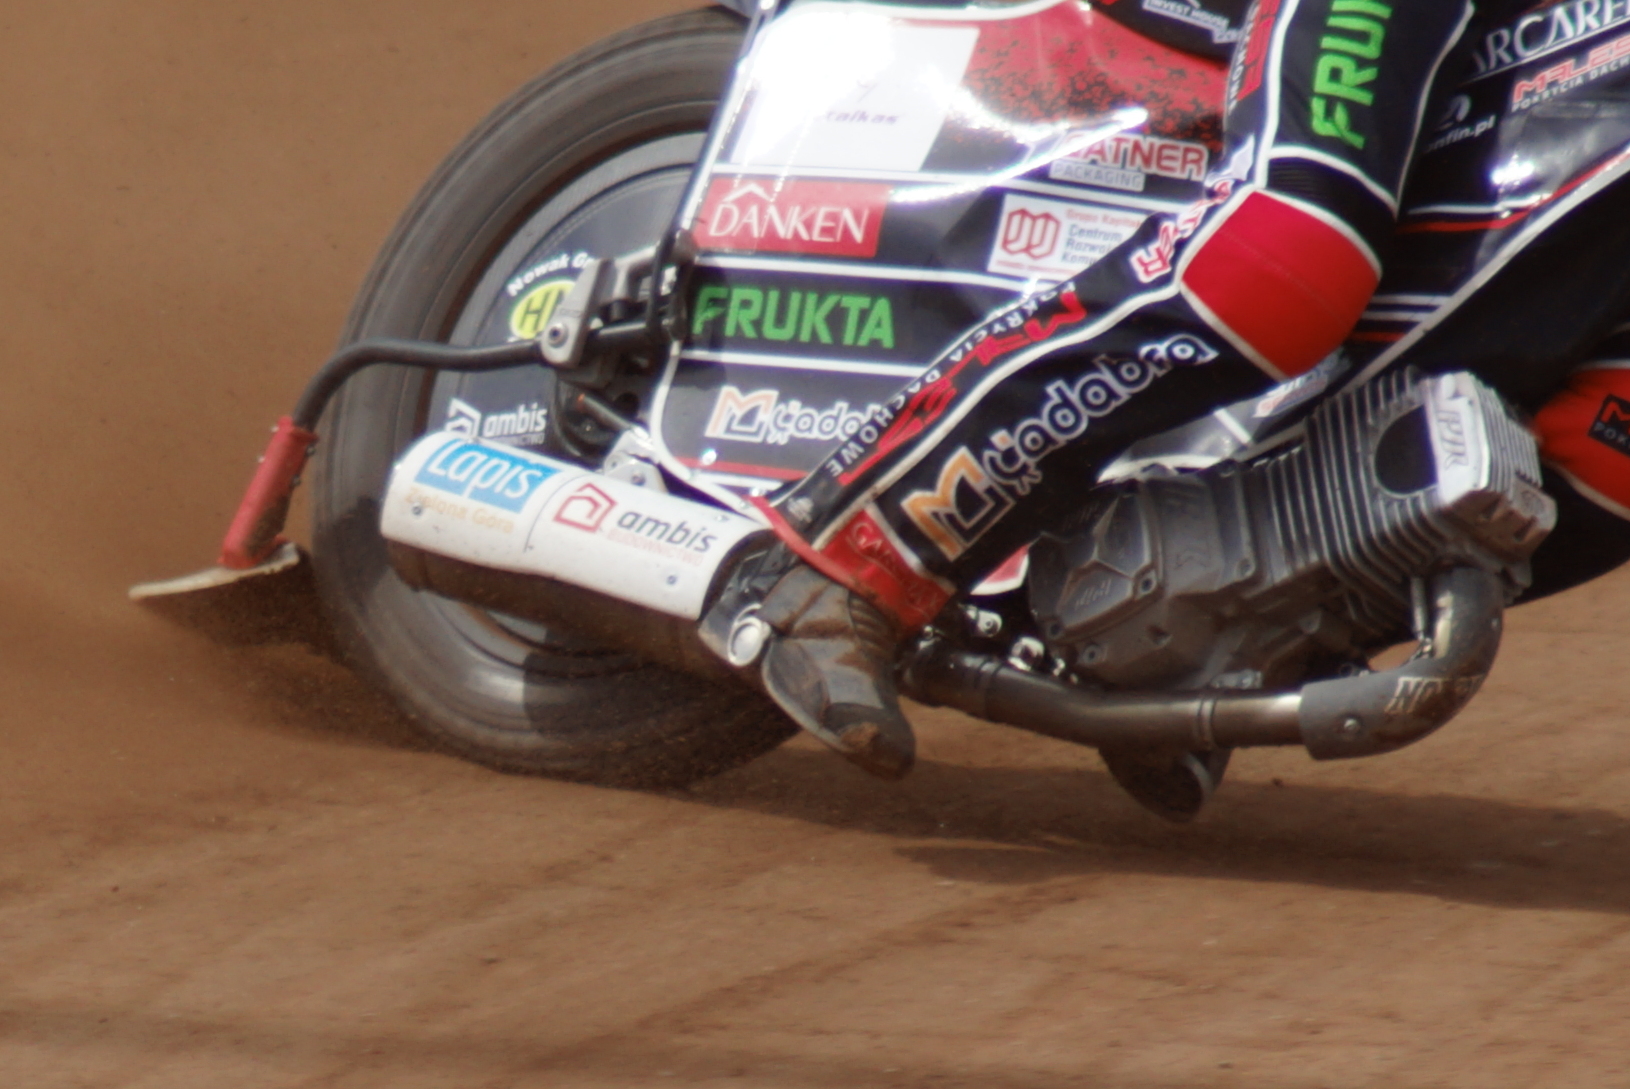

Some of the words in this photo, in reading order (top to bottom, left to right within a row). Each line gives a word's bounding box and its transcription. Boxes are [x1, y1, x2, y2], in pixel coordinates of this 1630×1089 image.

[1053, 162, 1144, 191] PACKAGING
[708, 203, 870, 244] DANKEN
[506, 252, 571, 297] Nowak
[692, 286, 895, 350] FRUKTA
[481, 402, 548, 438] ambis
[825, 368, 942, 478] DACHOWE
[426, 438, 544, 499] Lapis
[616, 510, 718, 553] ambis
